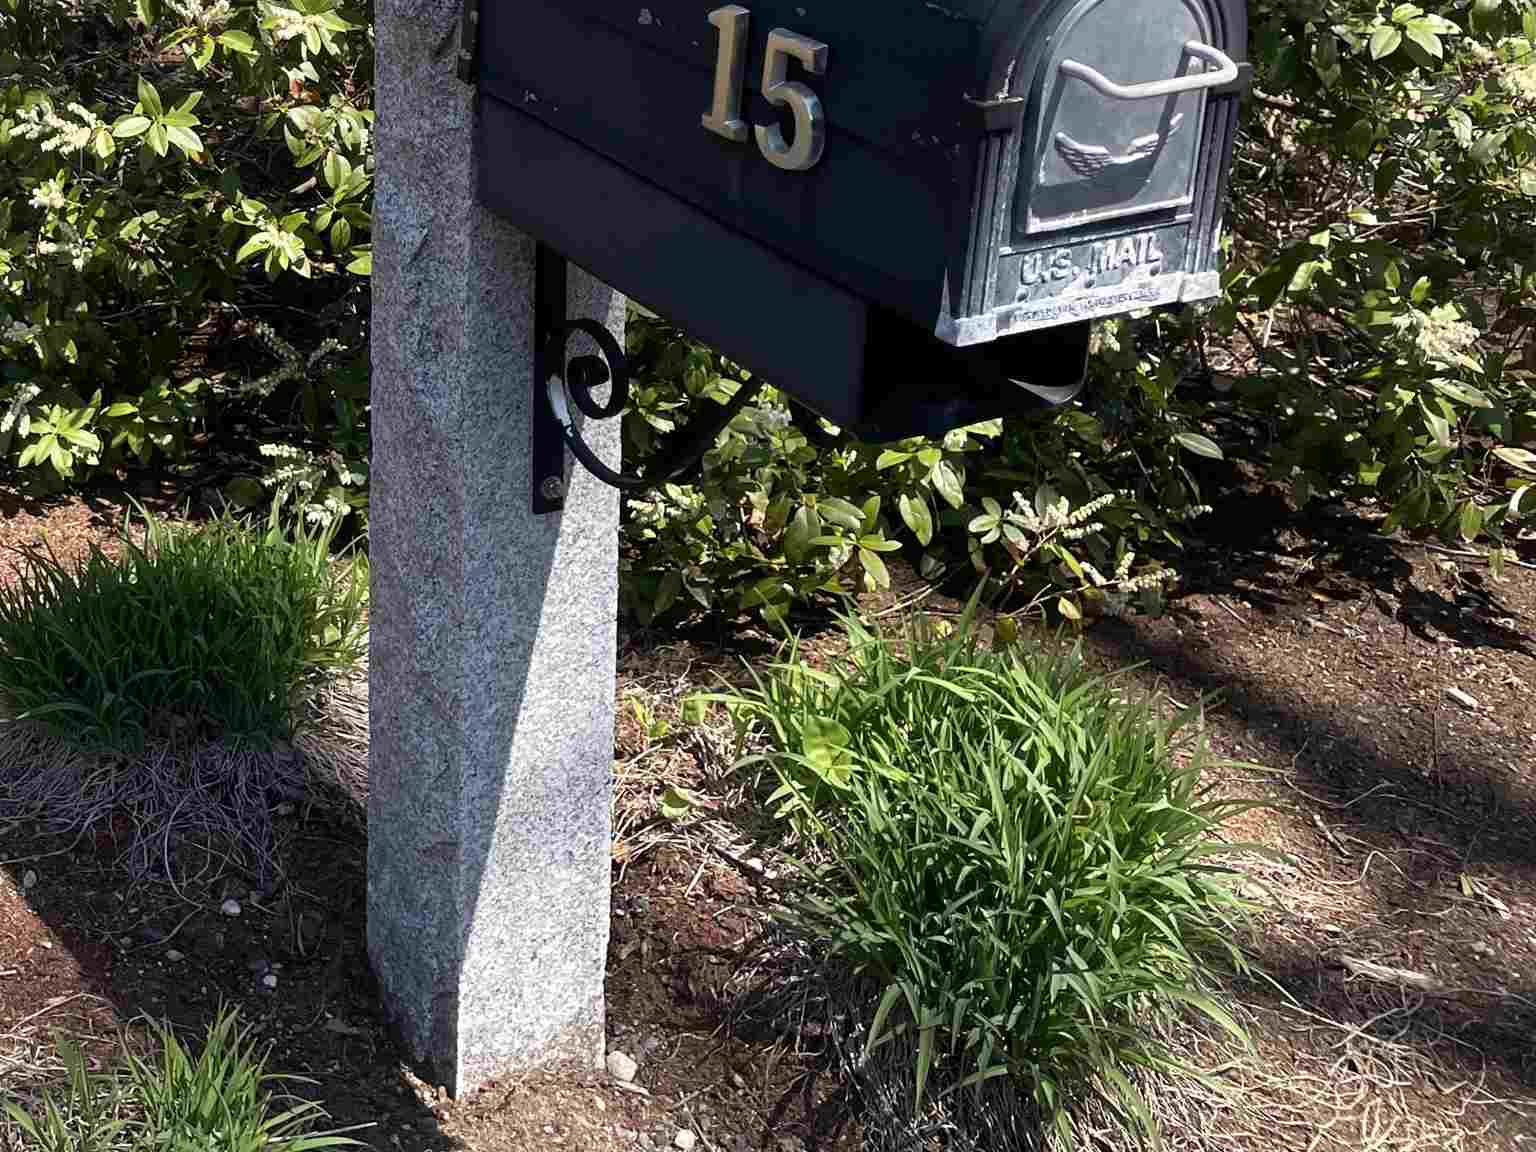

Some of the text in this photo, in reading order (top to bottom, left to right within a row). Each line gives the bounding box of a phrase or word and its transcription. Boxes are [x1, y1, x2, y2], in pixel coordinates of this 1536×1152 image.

[701, 4, 829, 171] 15
[1019, 232, 1164, 286] U.S. MAIL
